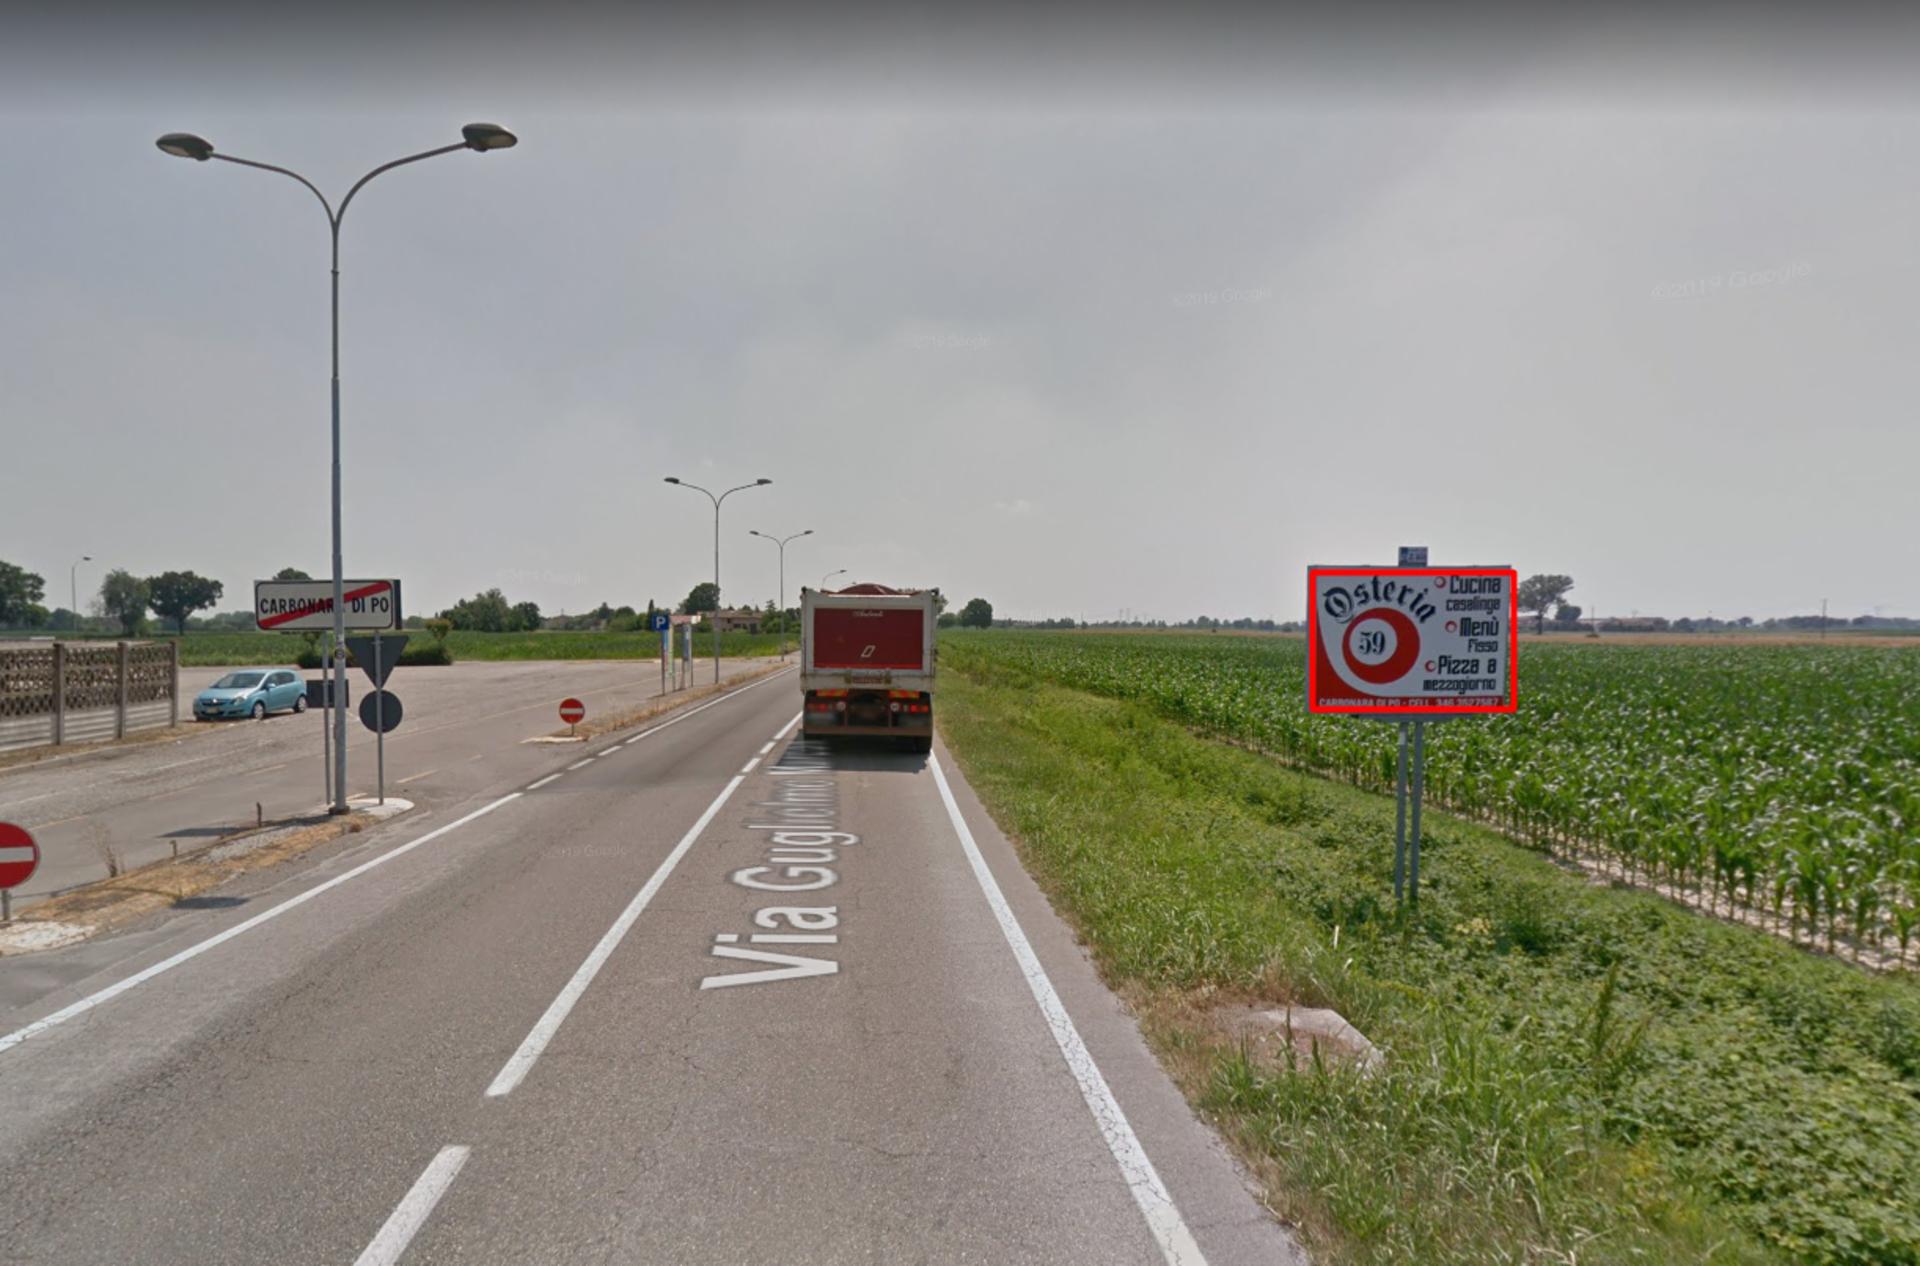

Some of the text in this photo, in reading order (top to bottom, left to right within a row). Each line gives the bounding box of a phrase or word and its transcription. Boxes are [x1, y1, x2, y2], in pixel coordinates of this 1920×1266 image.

[1450, 576, 1501, 593] Cucina
[260, 597, 389, 614] CARBONAR DI PO
[1322, 575, 1436, 624] Osteria
[1446, 596, 1500, 614] casalinga
[655, 616, 666, 629] P
[1460, 616, 1499, 636] Menù
[1359, 631, 1386, 655] 59
[1438, 655, 1497, 674] Pizza a
[1423, 676, 1497, 694] mezzogiorno
